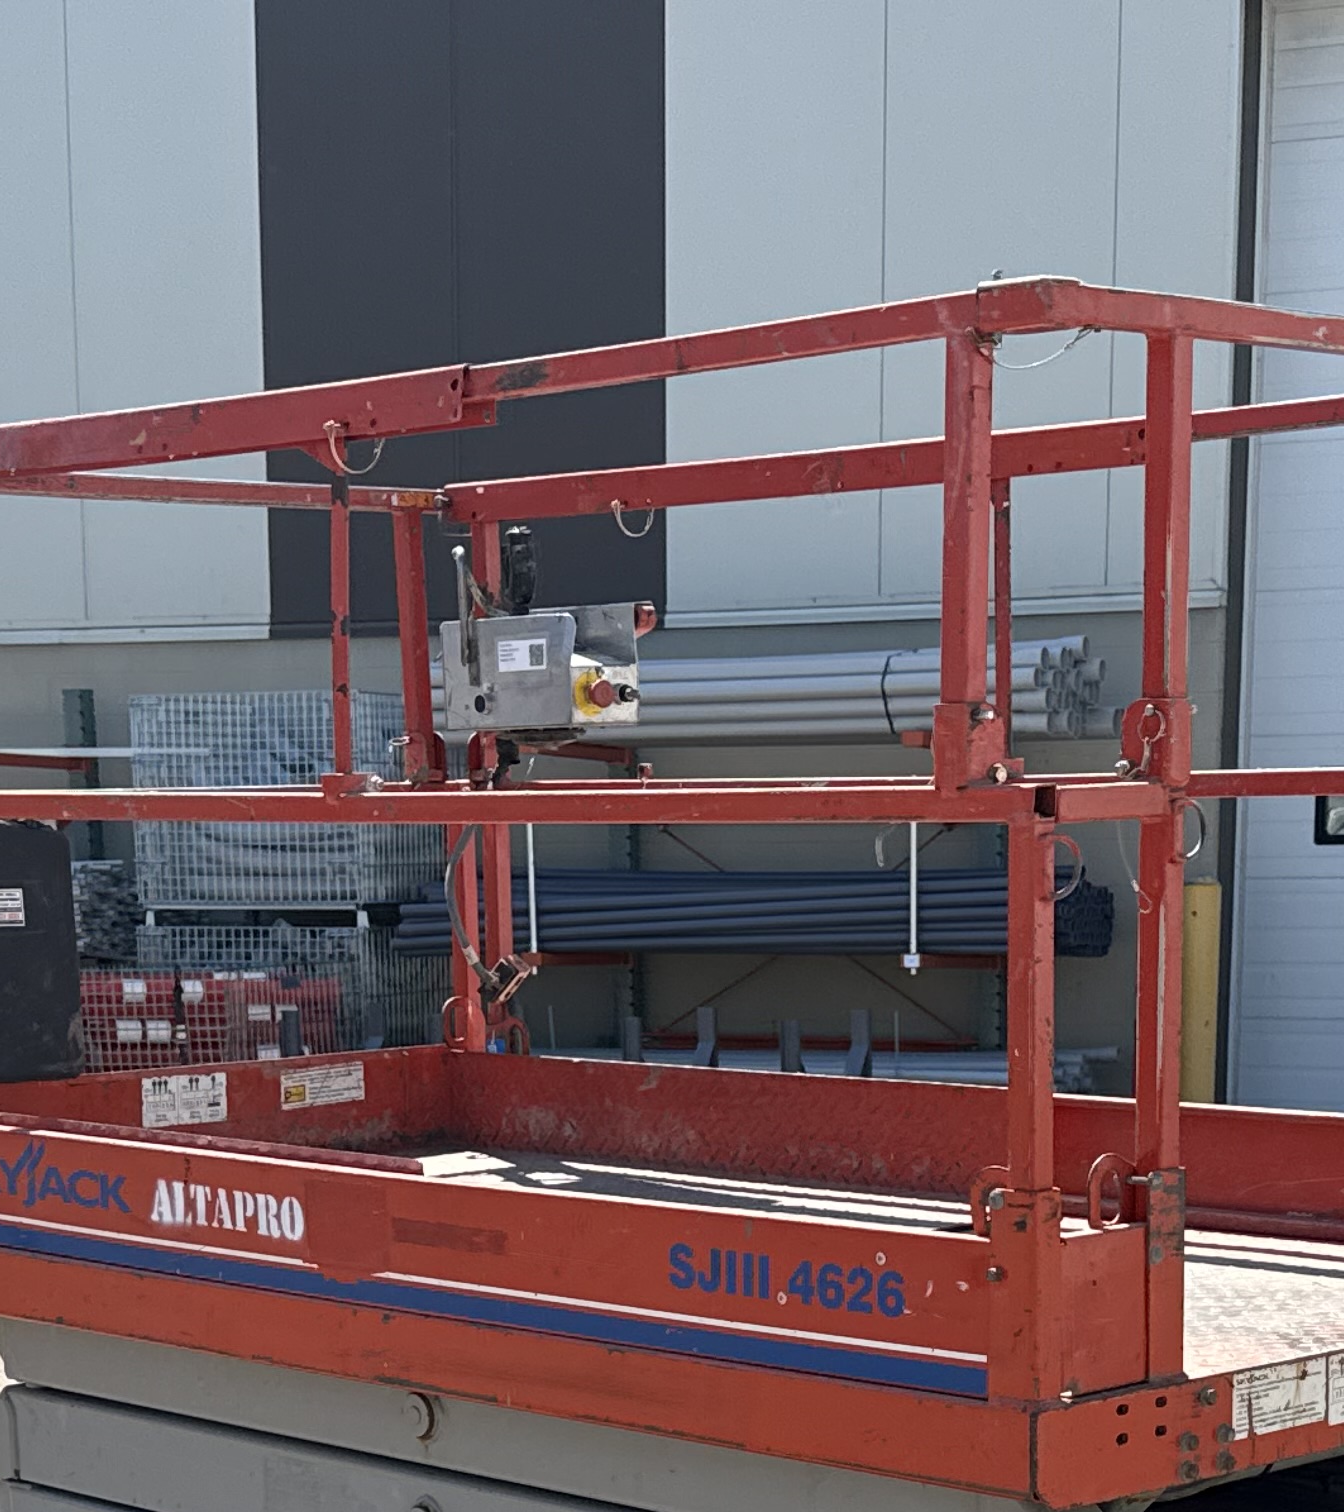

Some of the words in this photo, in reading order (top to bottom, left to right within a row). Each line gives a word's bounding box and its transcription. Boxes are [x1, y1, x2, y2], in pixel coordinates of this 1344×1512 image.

[151, 1178, 304, 1241] ALTAPRO
[669, 1243, 769, 1300] SJIII
[789, 1260, 905, 1318] 4626
